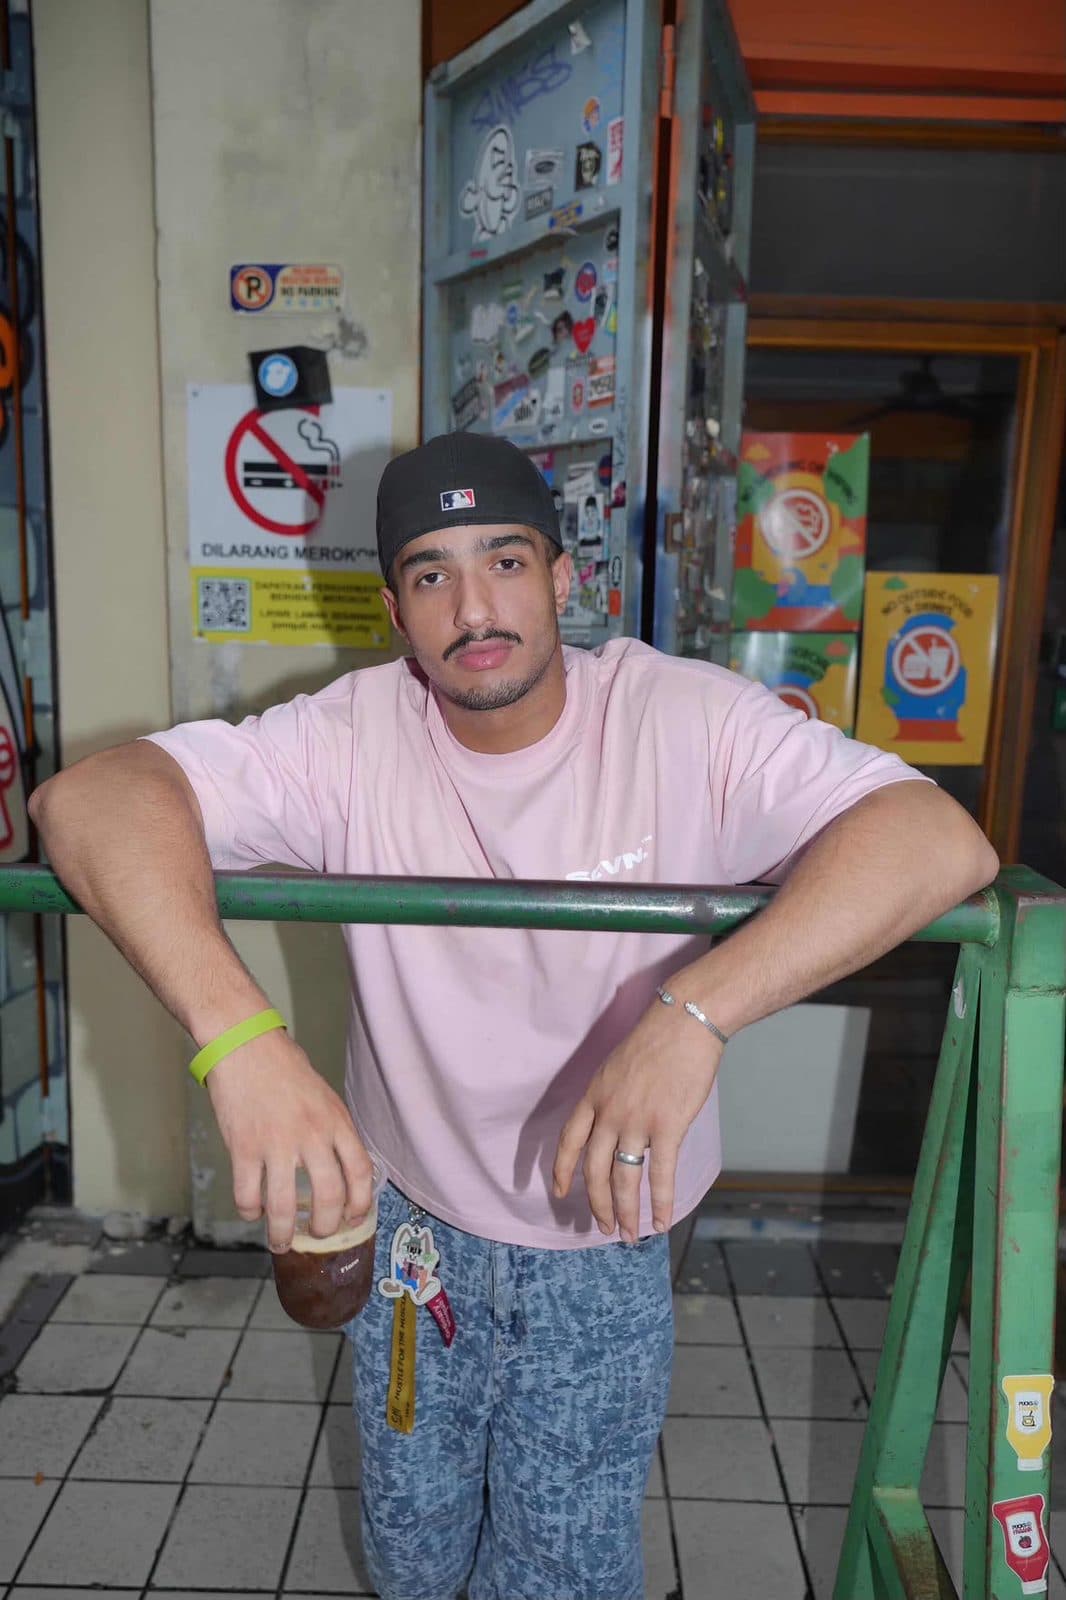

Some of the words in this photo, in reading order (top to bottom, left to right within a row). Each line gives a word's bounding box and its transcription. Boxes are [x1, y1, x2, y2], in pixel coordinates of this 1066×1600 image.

[299, 287, 340, 297] PARKING
[202, 543, 289, 559] DILARANG
[394, 1367, 404, 1401] HUSTLE
